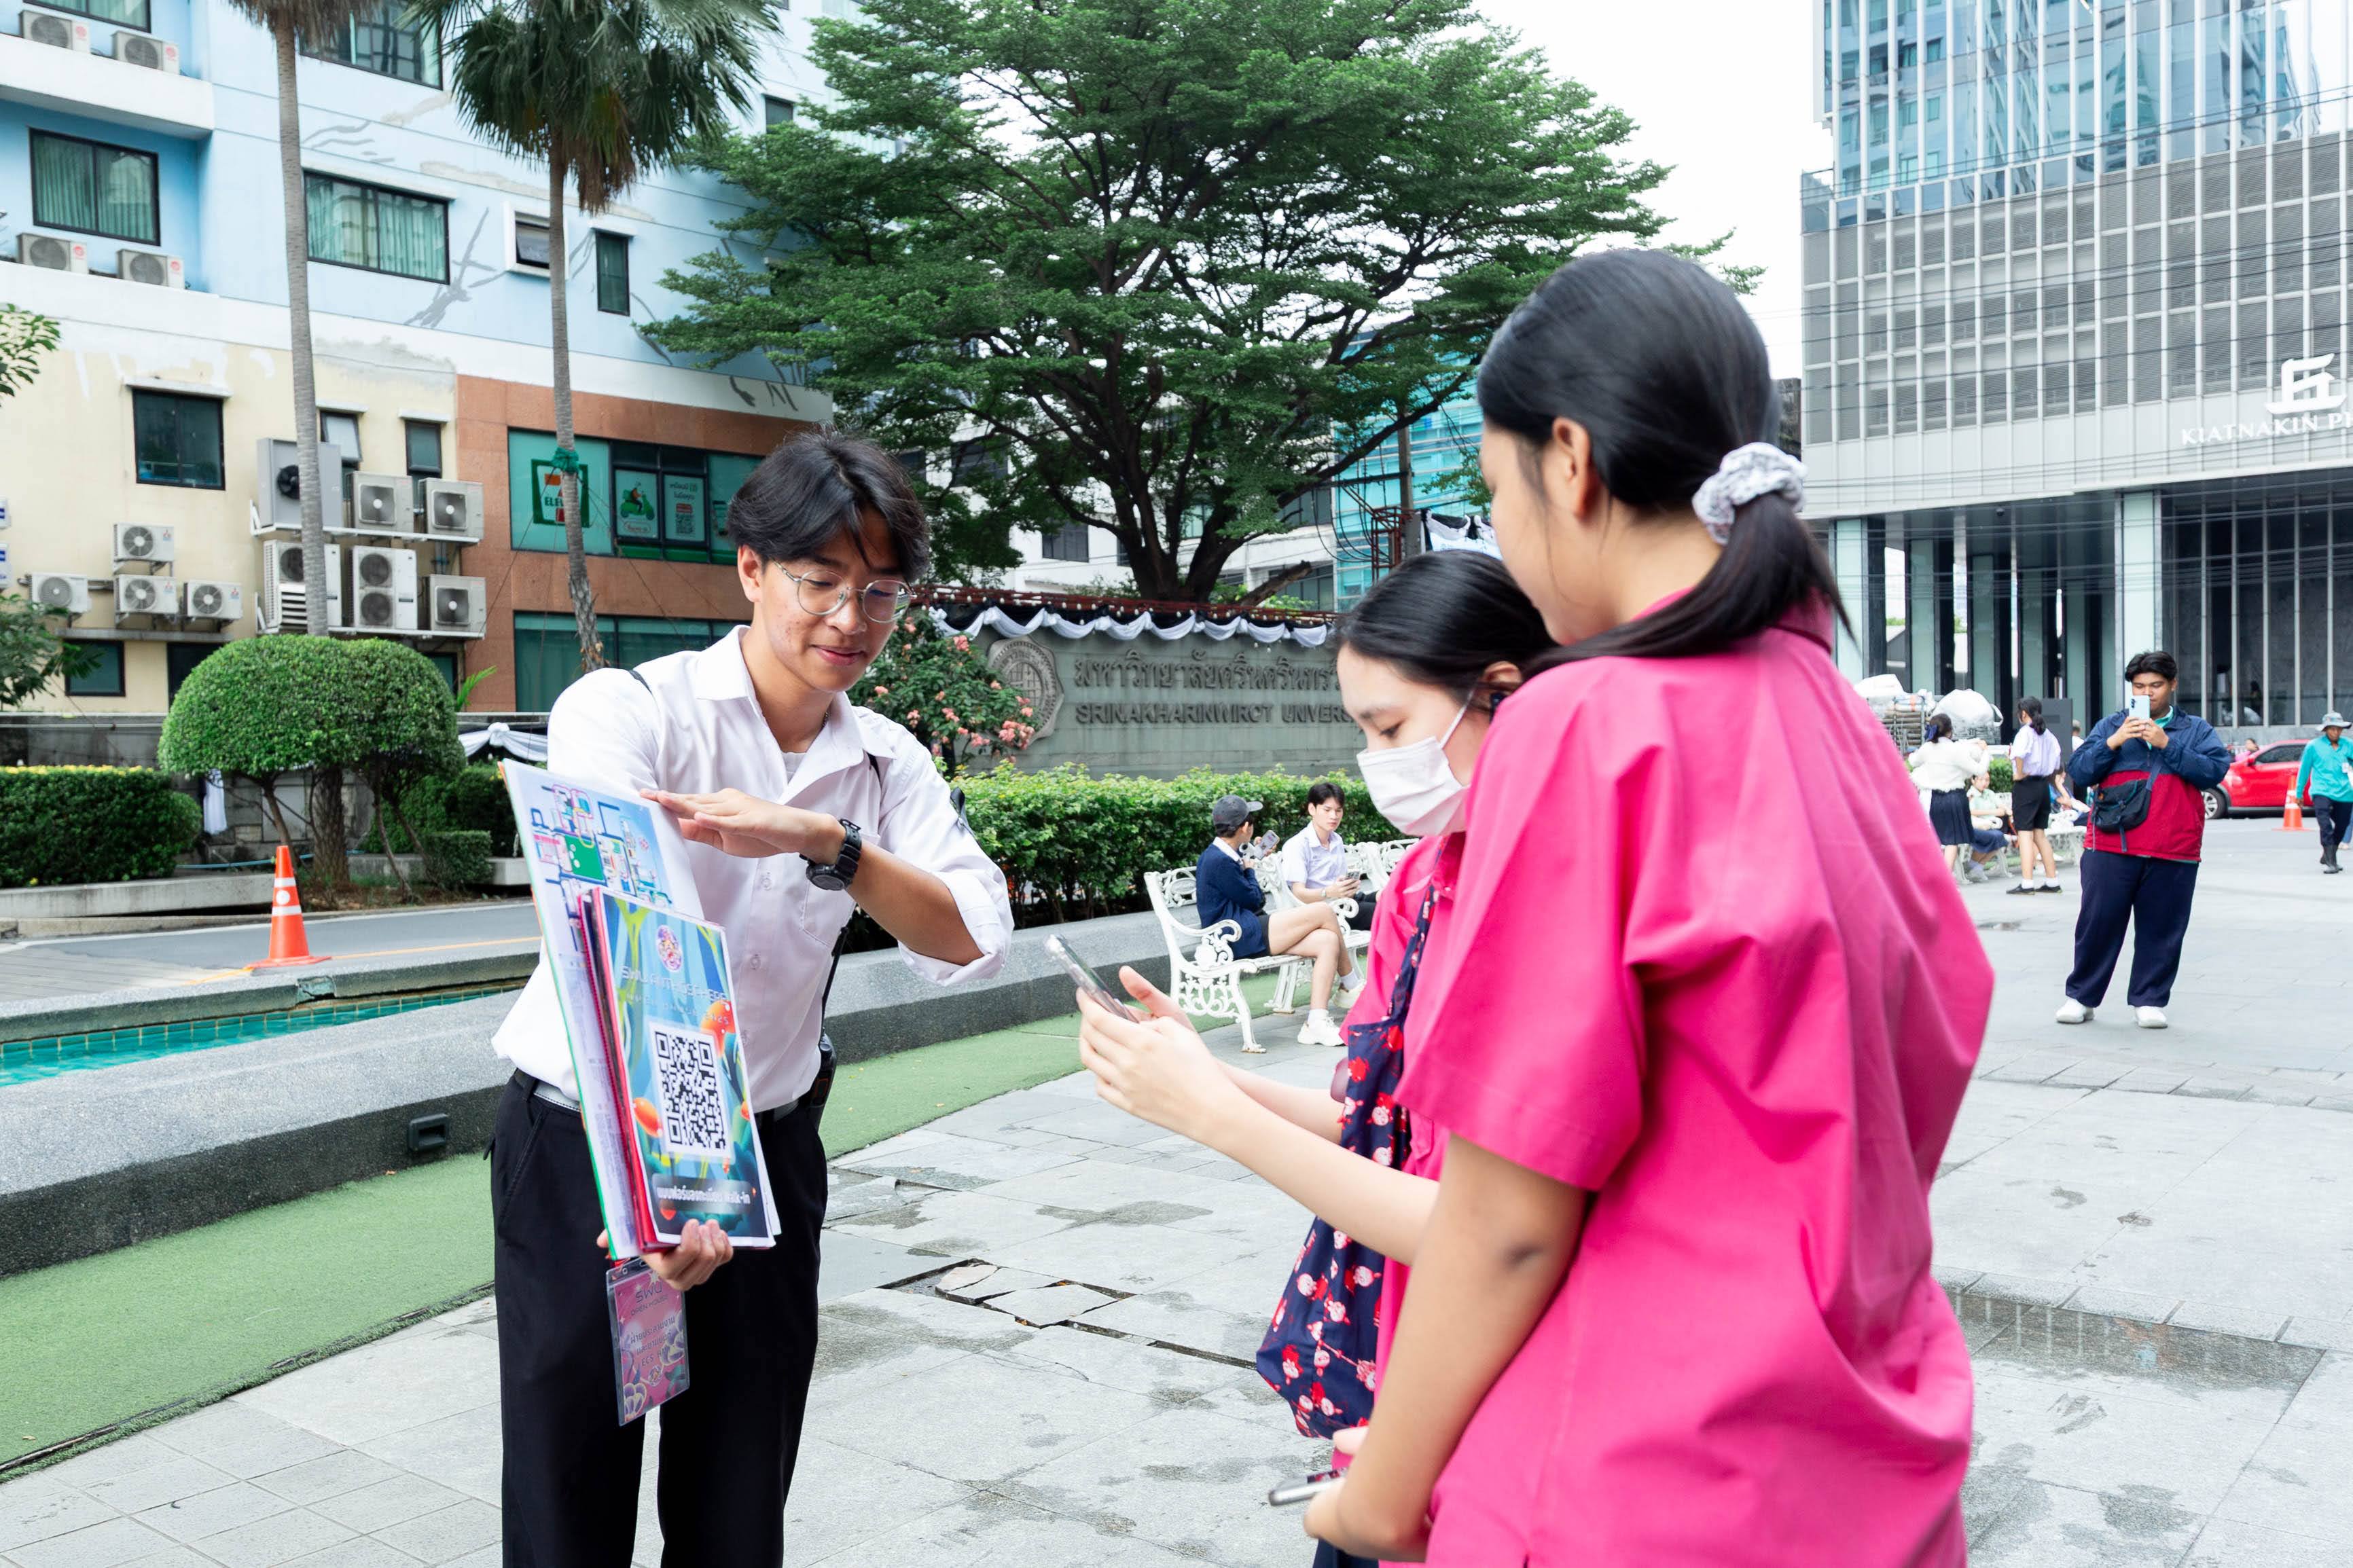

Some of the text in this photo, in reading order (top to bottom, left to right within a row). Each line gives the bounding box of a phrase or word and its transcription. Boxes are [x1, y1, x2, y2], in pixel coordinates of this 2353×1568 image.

[2181, 415, 2318, 446] KIATNAKIN
[1075, 648, 1341, 691] มหาวิทยาลัยศรีนครินทร
[1076, 702, 1274, 724] SRINAKHARINWIROT
[636, 1281, 663, 1304] SWU
